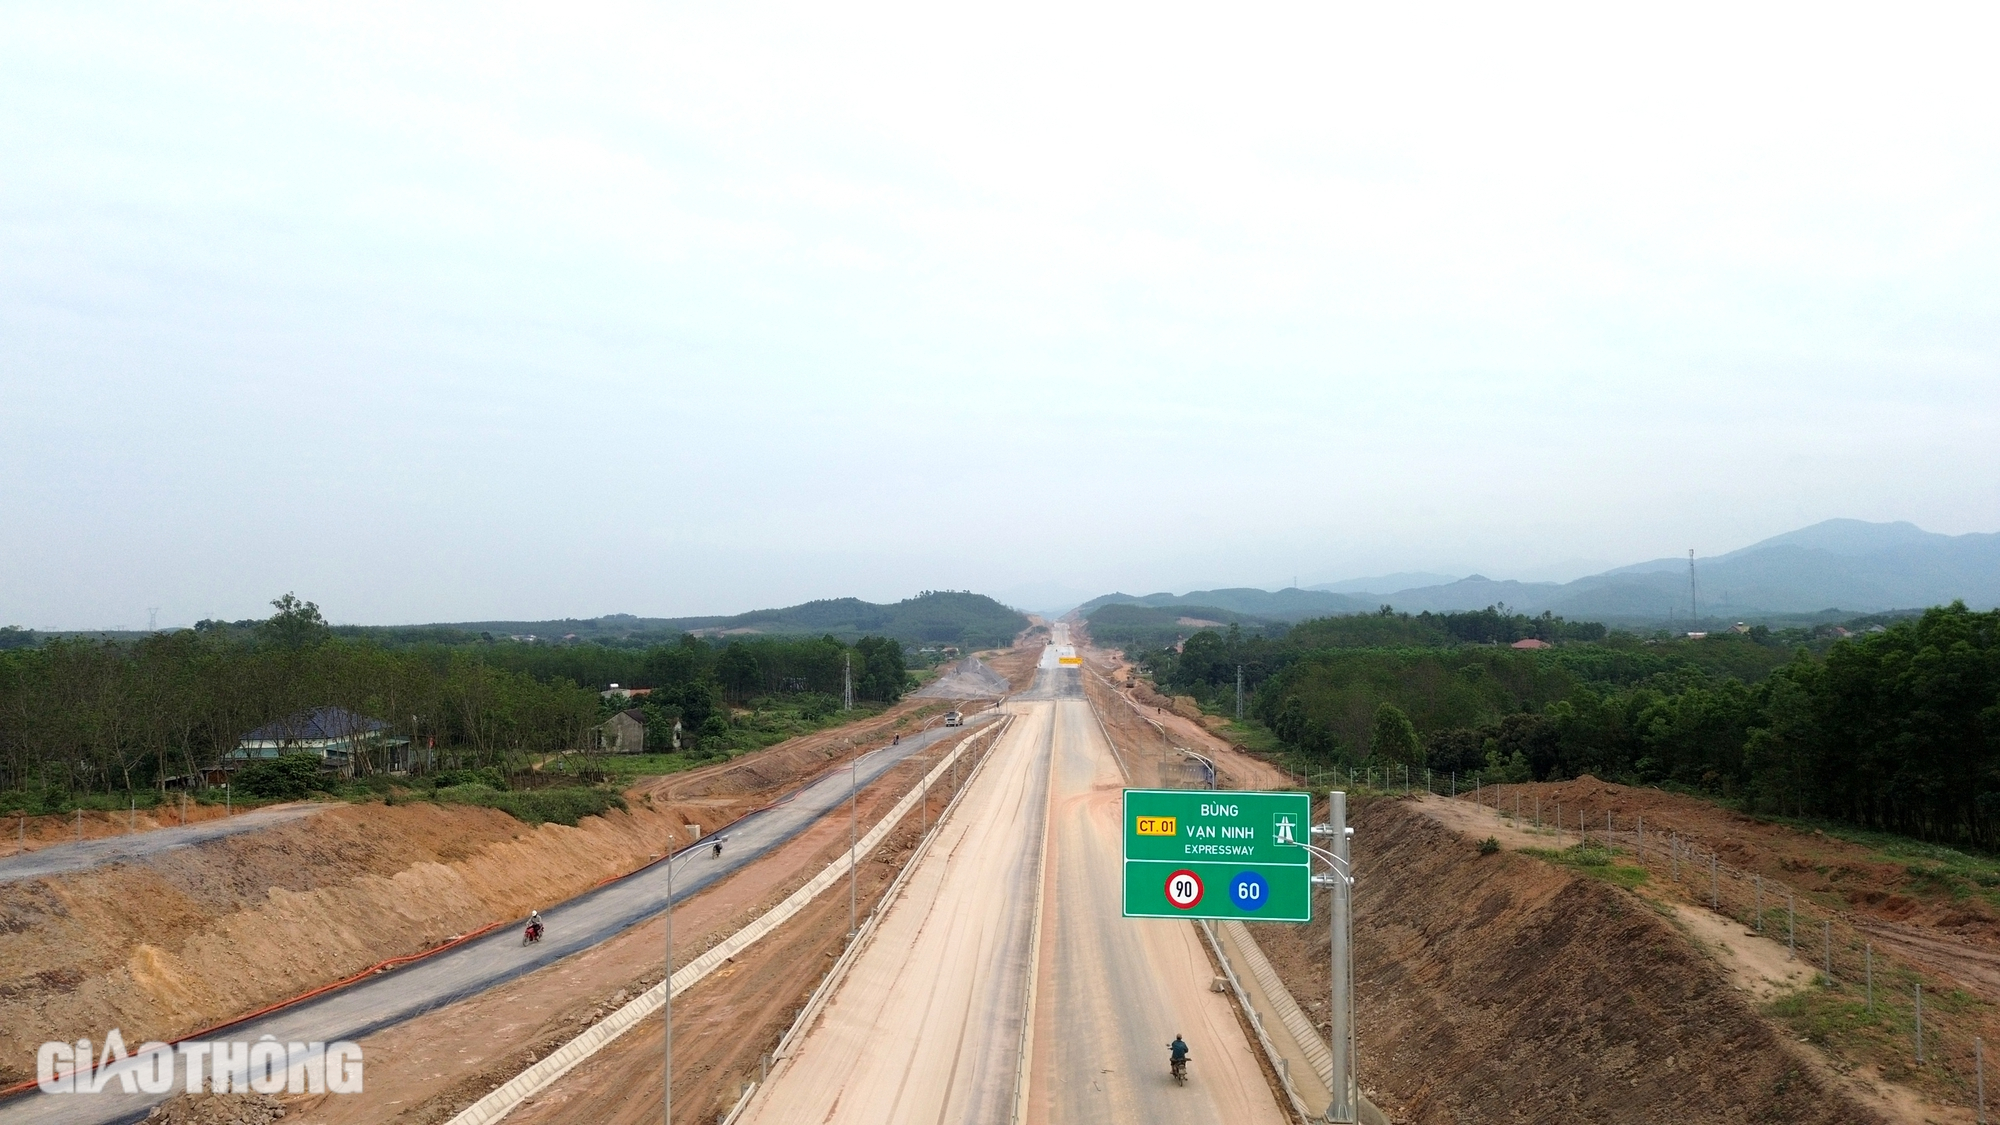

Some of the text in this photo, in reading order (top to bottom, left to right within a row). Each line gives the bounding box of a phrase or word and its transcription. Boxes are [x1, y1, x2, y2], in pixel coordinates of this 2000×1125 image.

[1200, 801, 1239, 817] BÙNG
[1186, 825, 1254, 840] VẠN NINH
[1184, 844, 1255, 856] EXPRESSWAY
[1175, 881, 1192, 898] 90
[1238, 882, 1260, 900] 60
